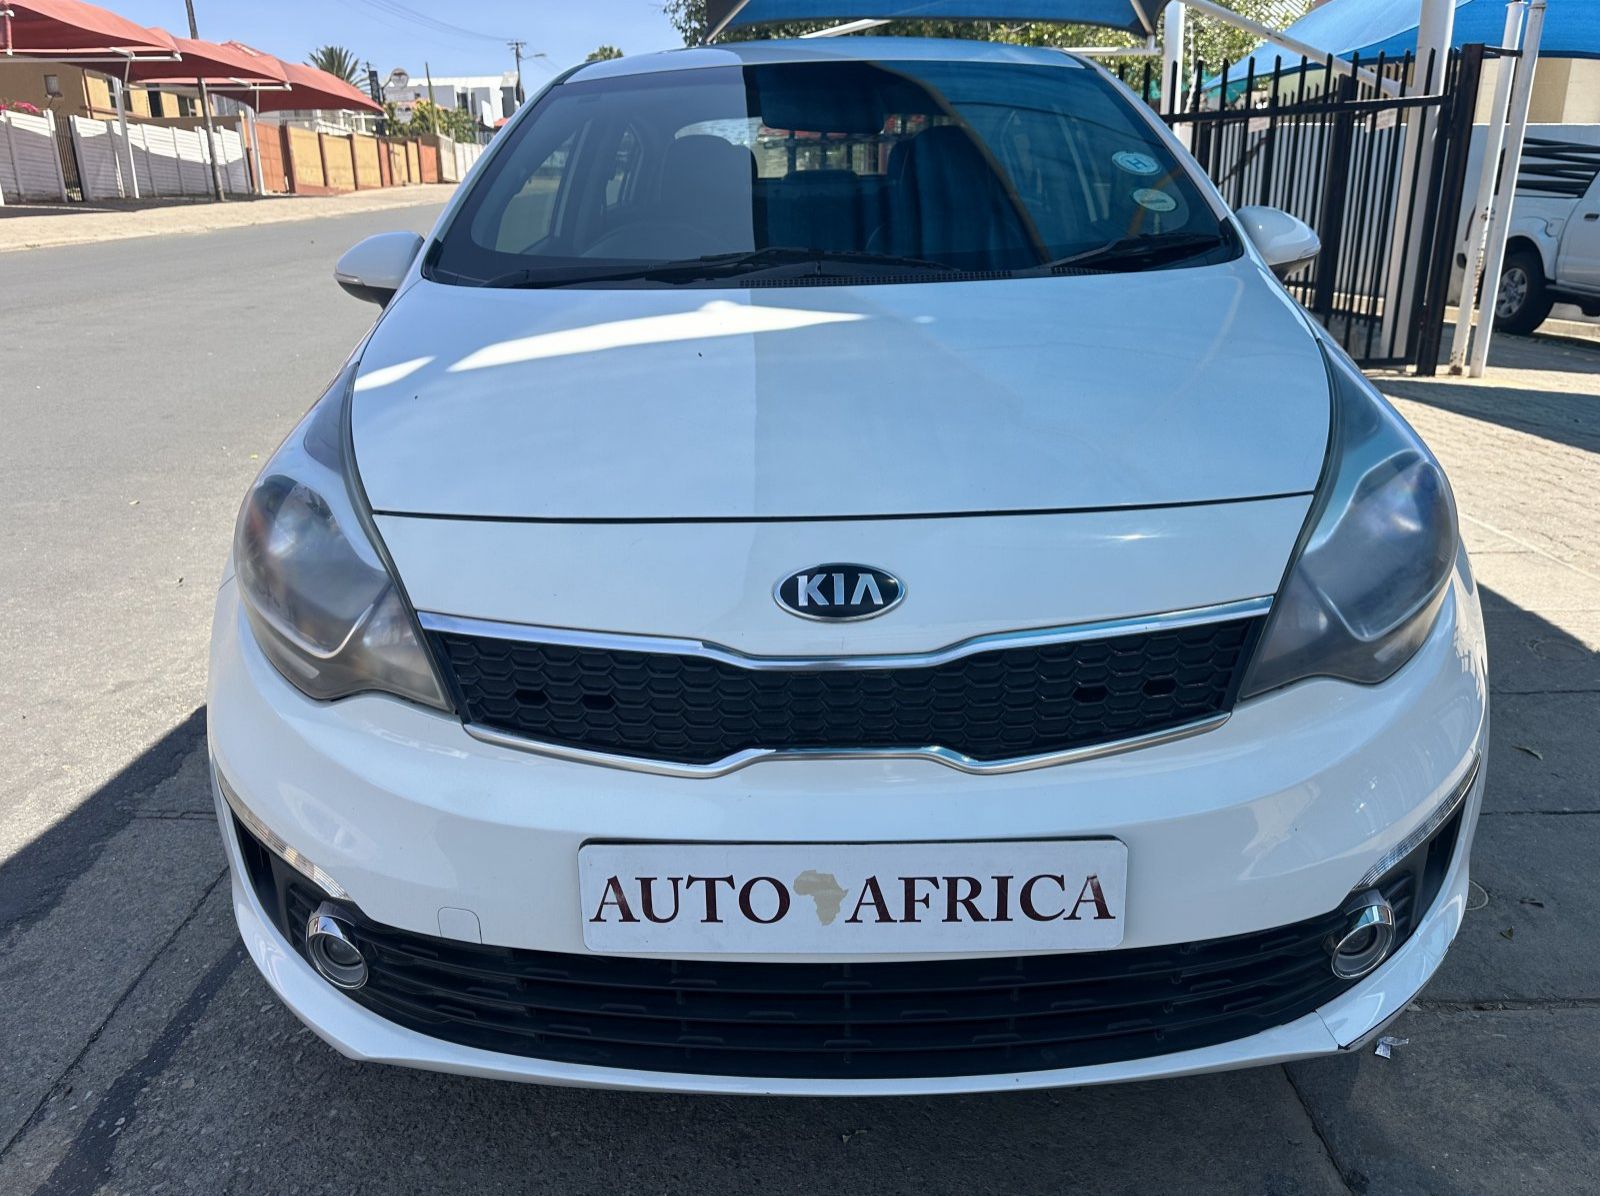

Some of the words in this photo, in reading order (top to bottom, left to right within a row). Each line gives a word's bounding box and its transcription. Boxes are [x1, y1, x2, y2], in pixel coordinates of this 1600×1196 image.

[796, 572, 884, 607] KIA
[588, 874, 791, 924] AUTO
[844, 873, 1116, 923] AFRICA
